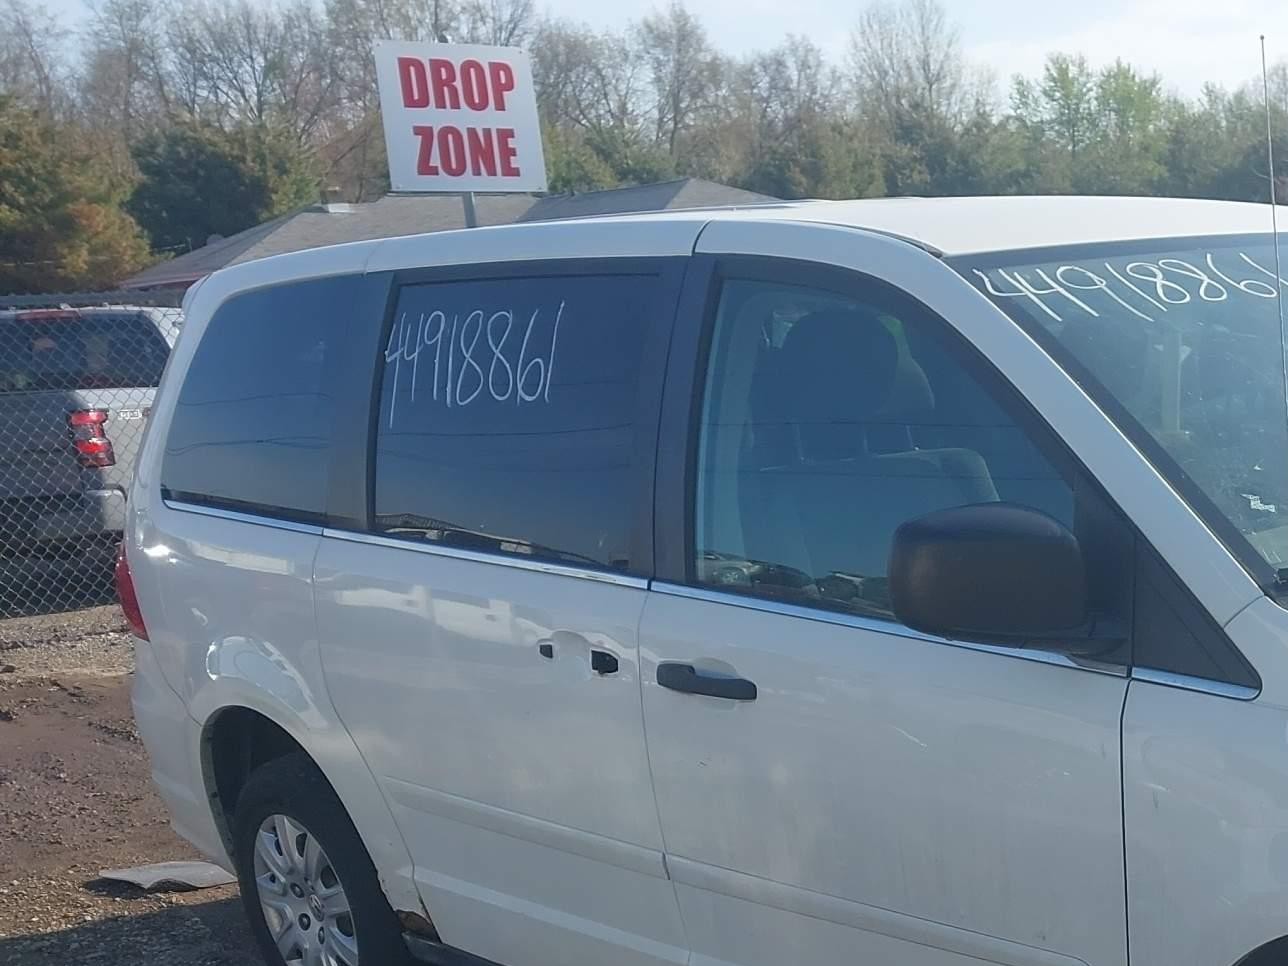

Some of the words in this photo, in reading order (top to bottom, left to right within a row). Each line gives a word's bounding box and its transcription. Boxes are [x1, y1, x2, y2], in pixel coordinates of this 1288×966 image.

[397, 57, 515, 112] DROP
[413, 125, 521, 177] ZONE
[385, 299, 565, 429] 44918861
